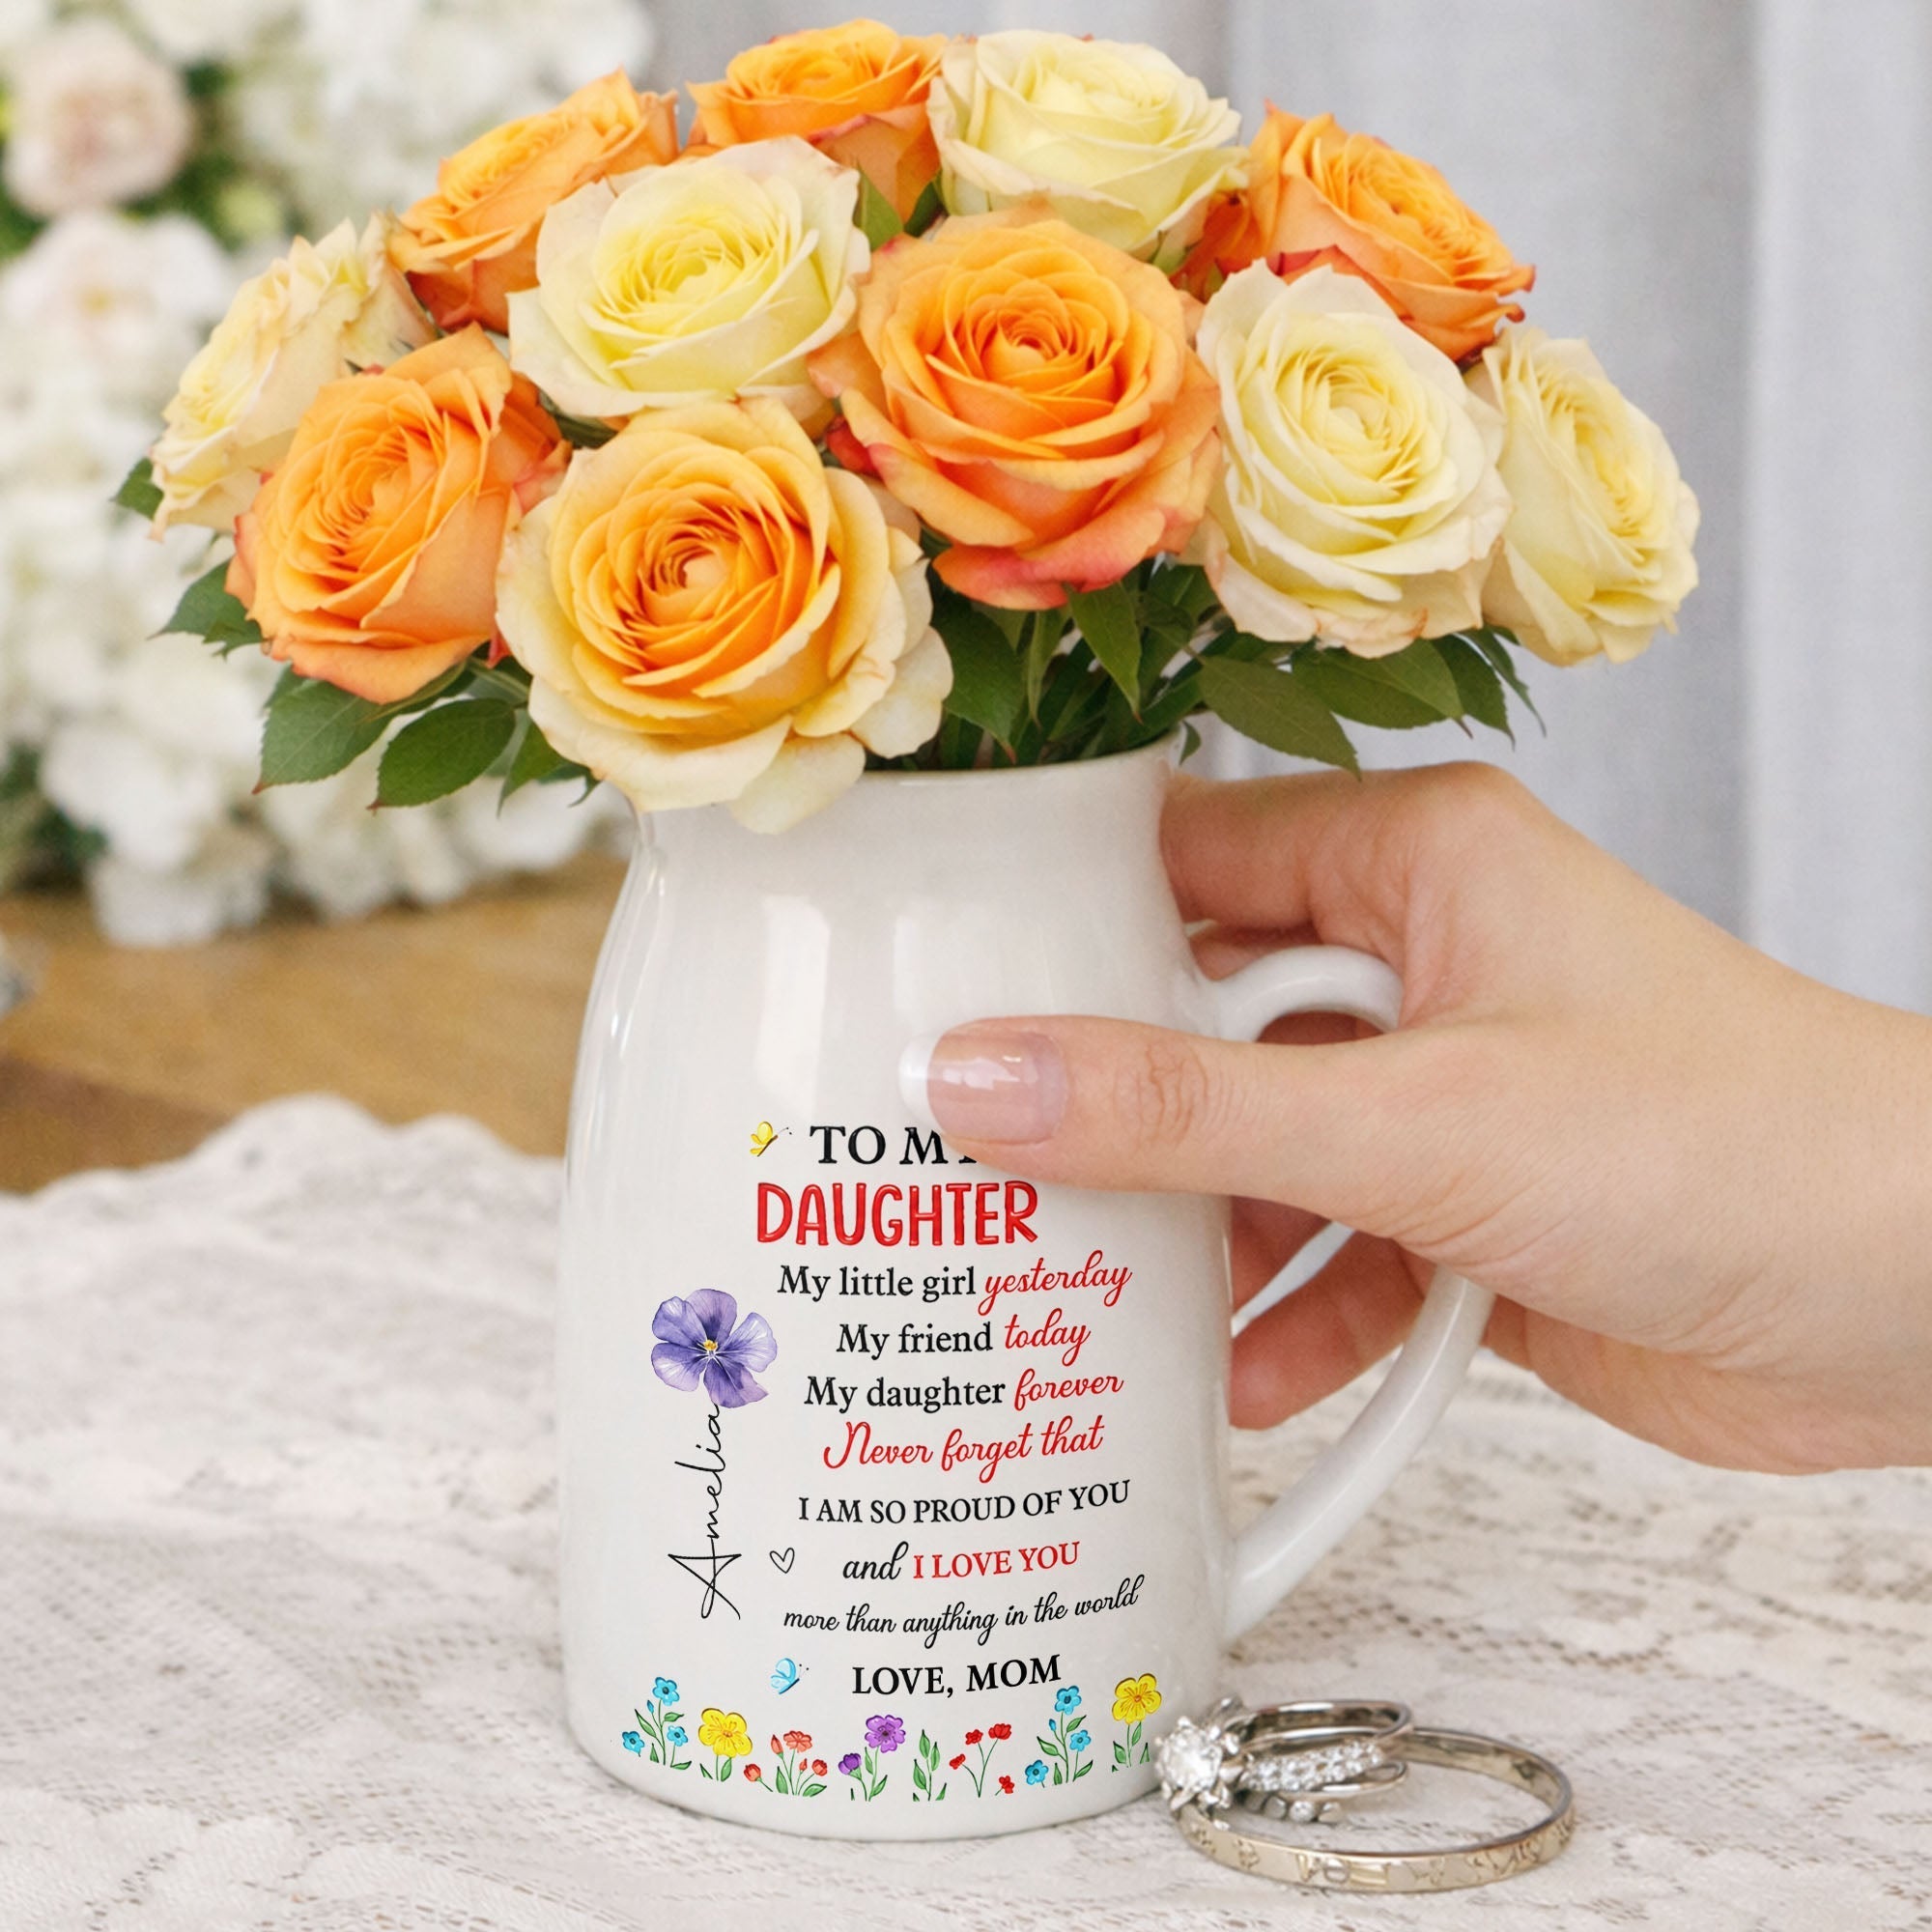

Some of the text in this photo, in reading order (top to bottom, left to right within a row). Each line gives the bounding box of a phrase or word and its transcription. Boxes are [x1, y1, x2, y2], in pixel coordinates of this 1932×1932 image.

[809, 1125, 978, 1165] TO M
[756, 1180, 1038, 1247] DAUGHTER
[777, 1249, 1133, 1319] My little girl yesterday
[836, 1307, 1092, 1368] My friend today
[803, 1368, 1124, 1414] My daughter forever
[823, 1414, 1105, 1484] Never forget that
[667, 1404, 742, 1620] Amelia
[798, 1478, 1131, 1524] I AM SO PROUD OF YOU
[842, 1540, 1080, 1580] and I LOVE YOU
[783, 1574, 1146, 1650] more than anything in the world
[852, 1654, 1062, 1699] LOVE, MOM
